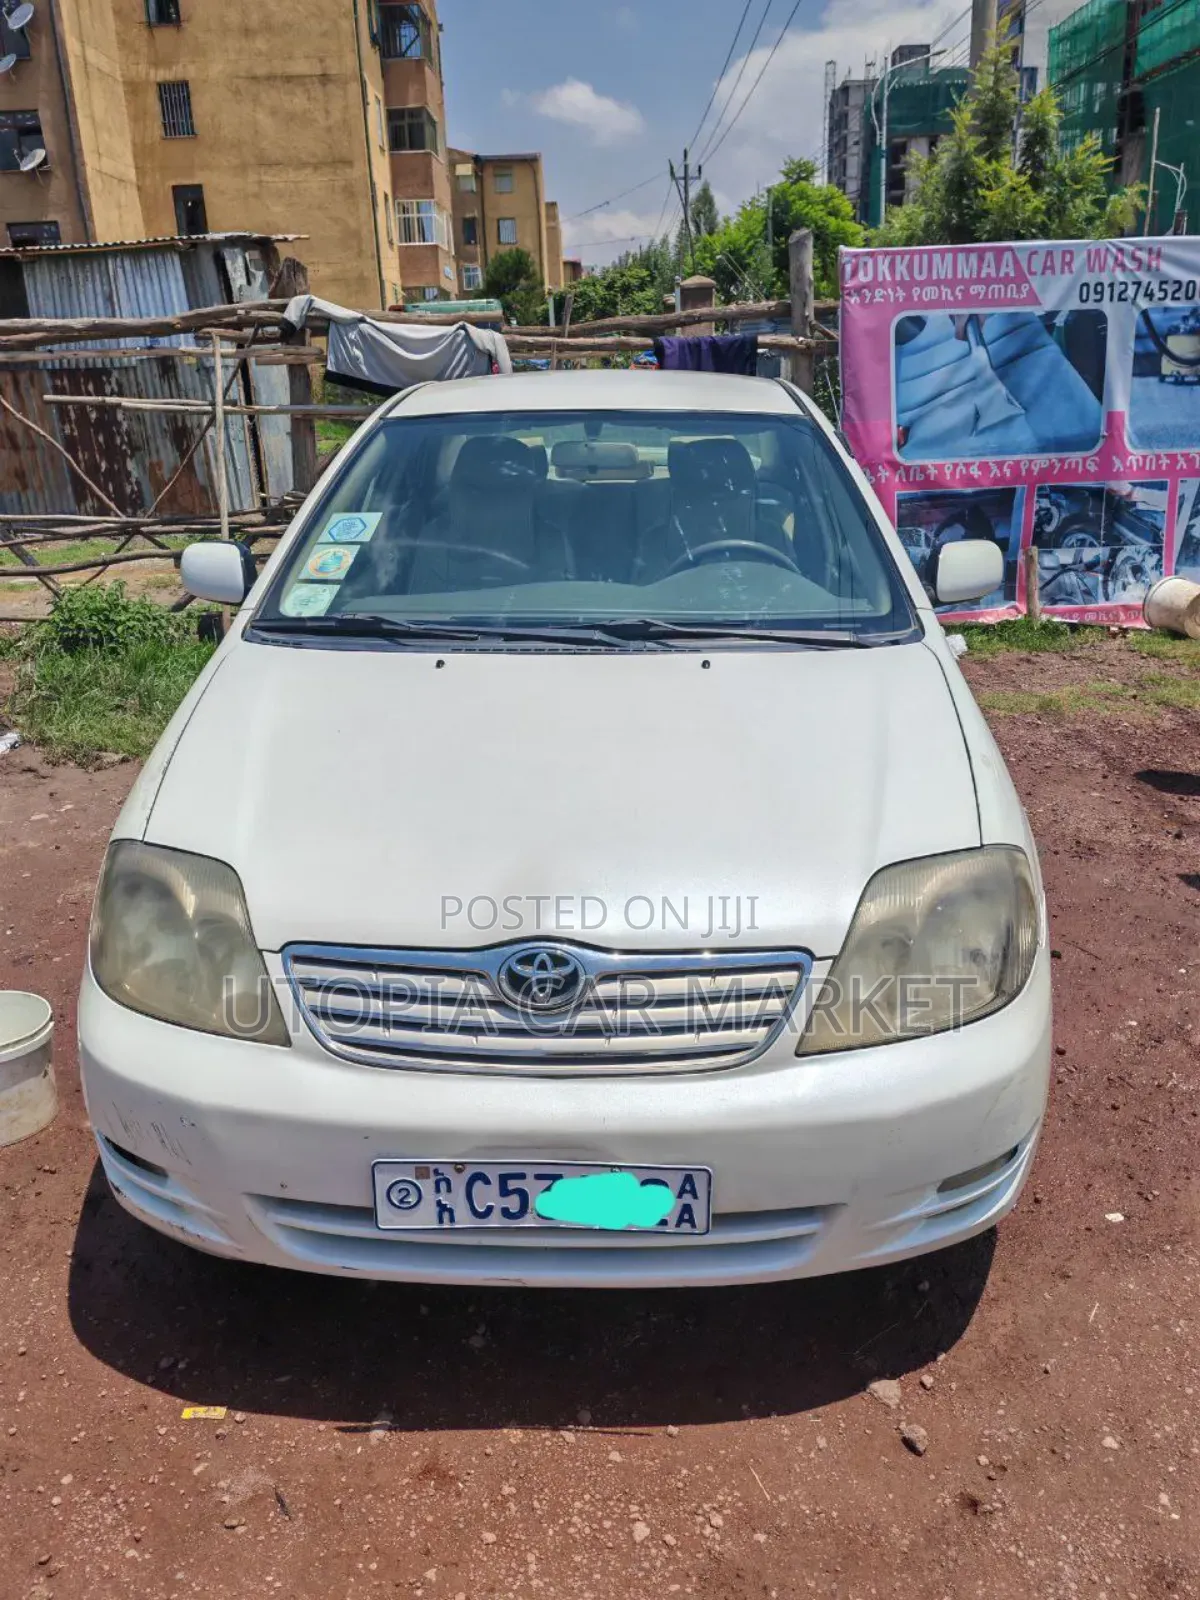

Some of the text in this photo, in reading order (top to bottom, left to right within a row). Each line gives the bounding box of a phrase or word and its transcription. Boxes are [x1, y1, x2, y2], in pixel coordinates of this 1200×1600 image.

[1027, 248, 1075, 277] CAR
[1086, 247, 1162, 274] WASH
[1078, 279, 1200, 304] 091274520
